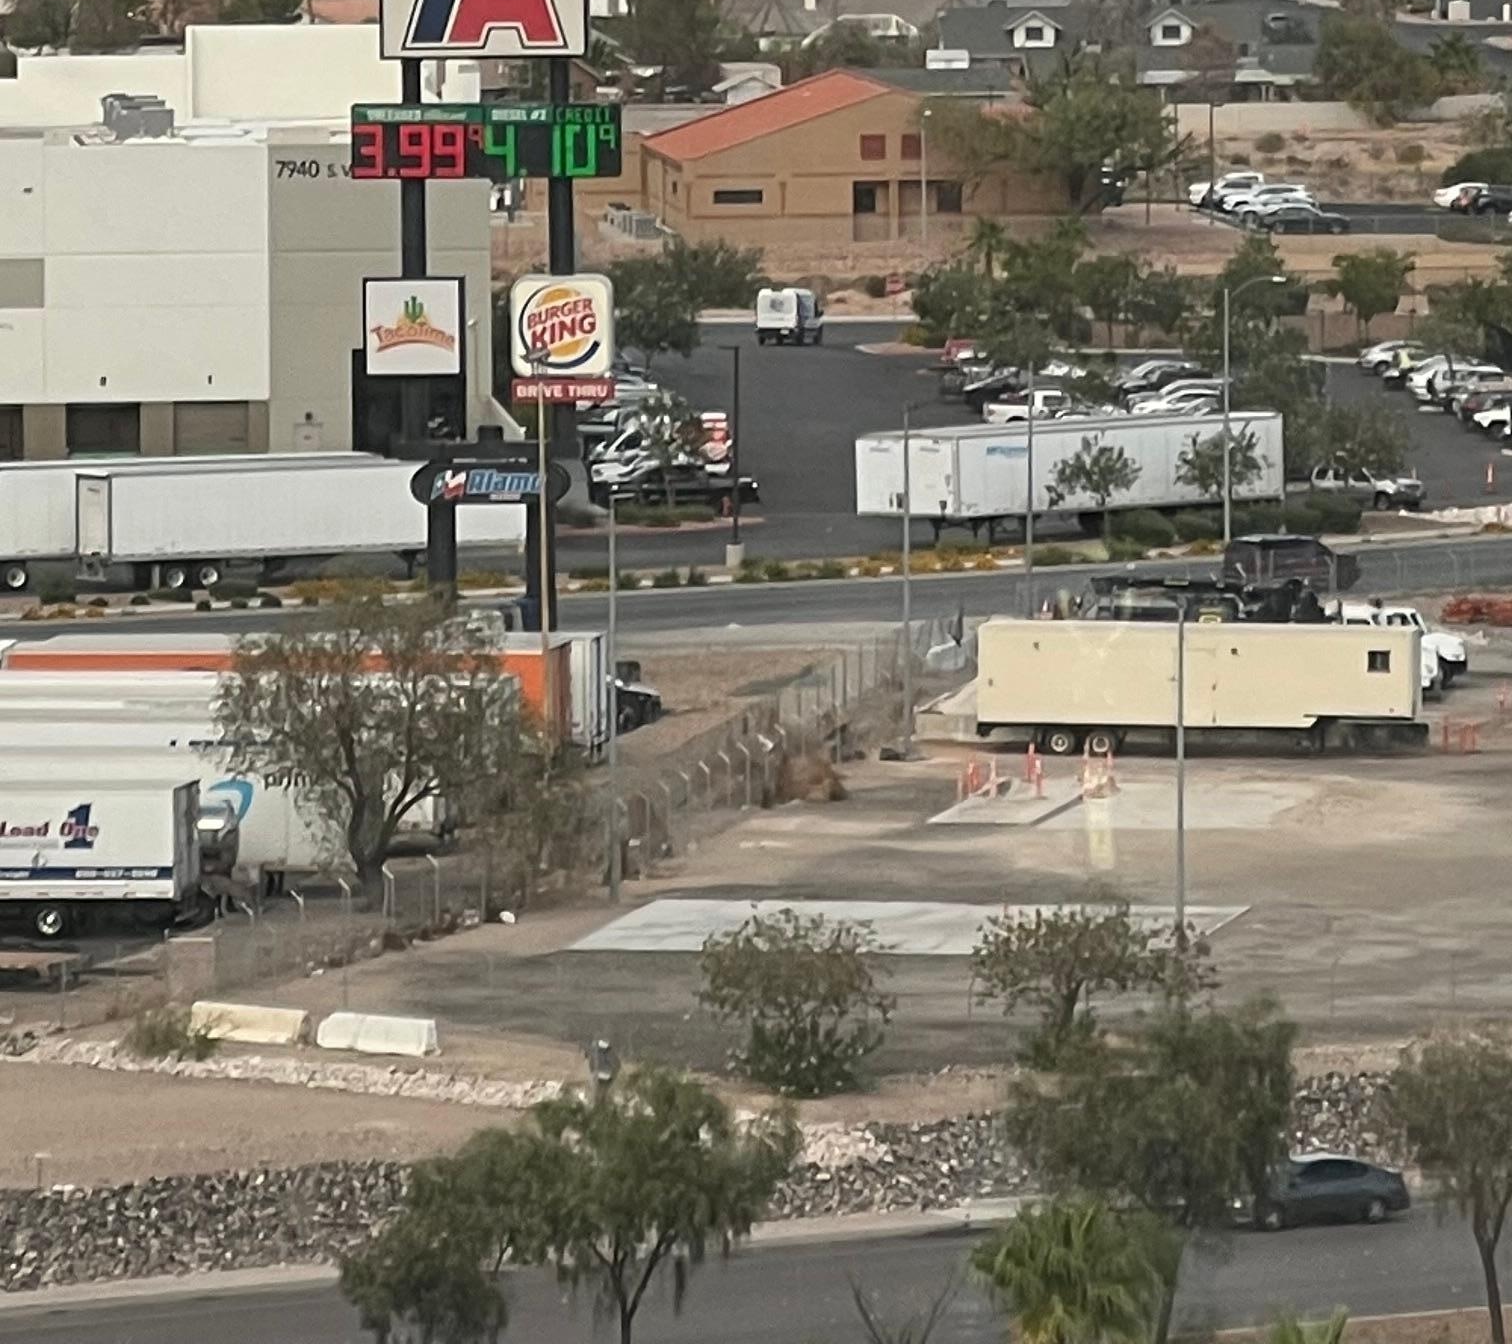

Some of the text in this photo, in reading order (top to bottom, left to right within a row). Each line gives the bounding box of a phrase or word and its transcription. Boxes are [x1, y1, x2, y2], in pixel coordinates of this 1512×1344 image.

[352, 123, 465, 178] 3.99
[275, 160, 320, 178] 7940
[527, 297, 593, 330] BURGER
[530, 313, 596, 351] KING
[516, 384, 608, 398] DRVE THRU
[0, 819, 50, 838] Load
